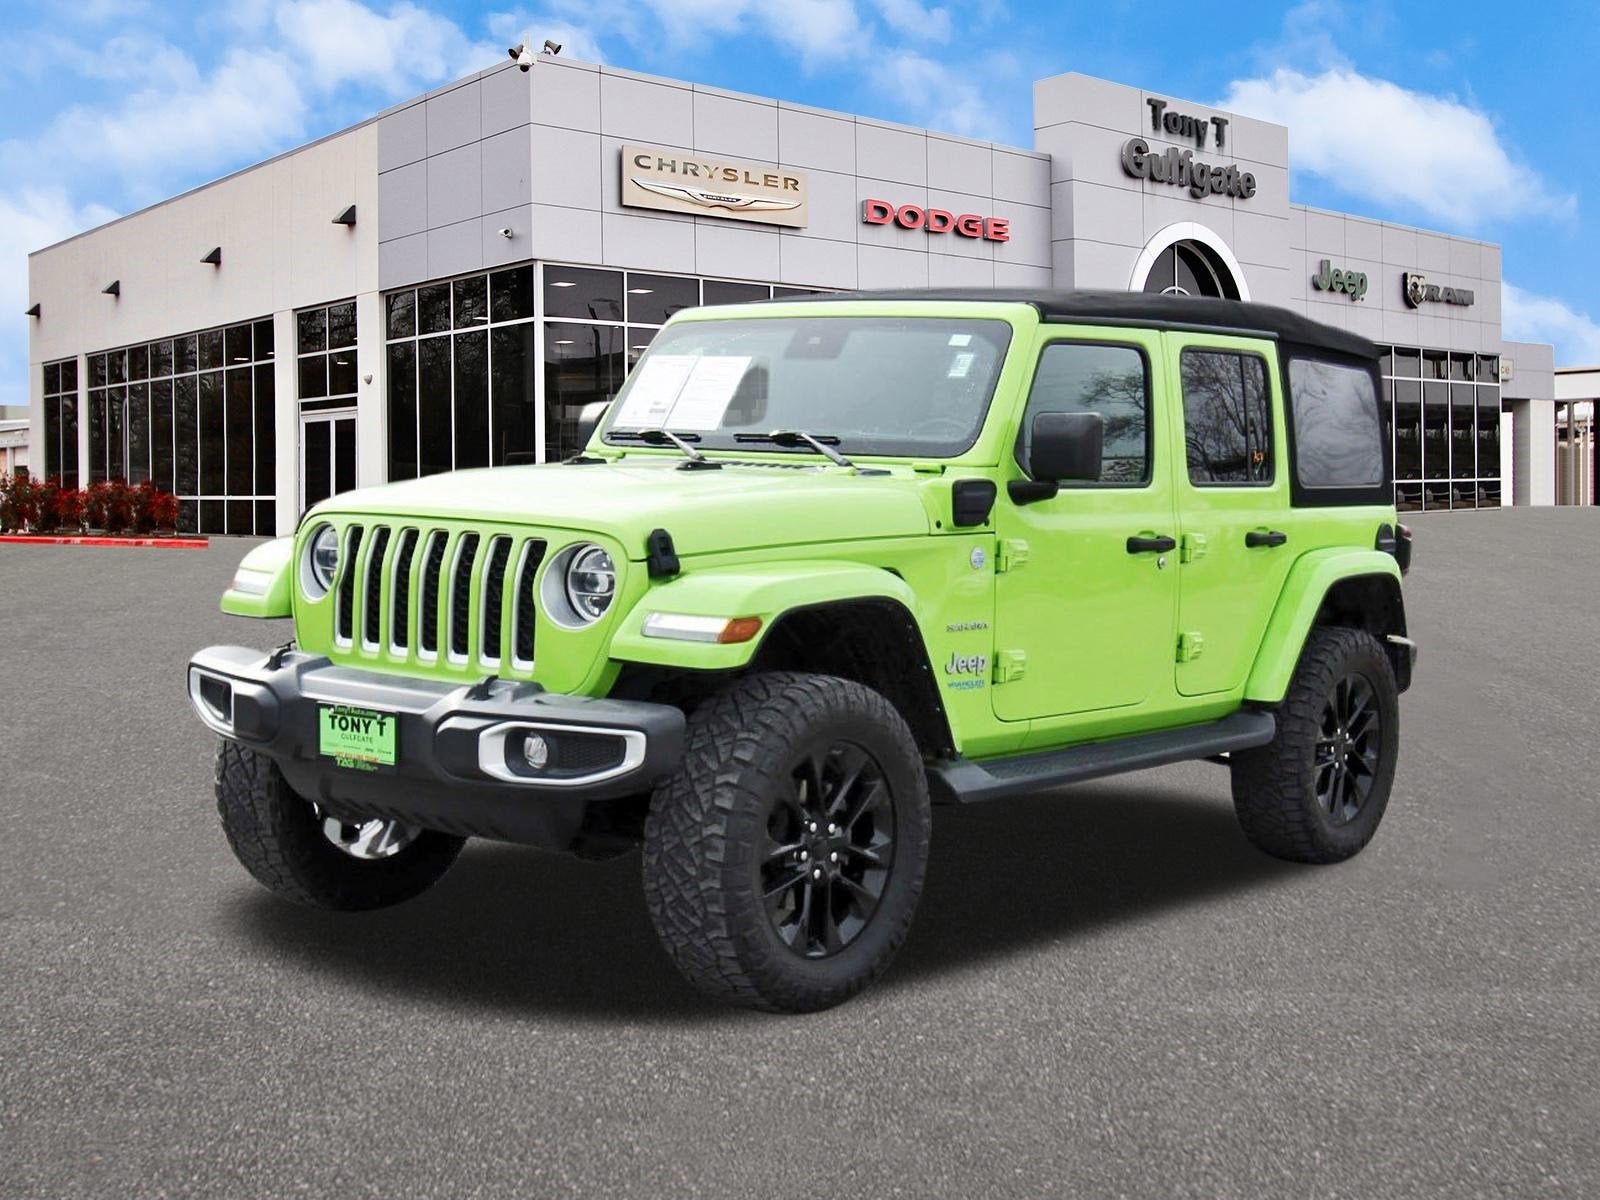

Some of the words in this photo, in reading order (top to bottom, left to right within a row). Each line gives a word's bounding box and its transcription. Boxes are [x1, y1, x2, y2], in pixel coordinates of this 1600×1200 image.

[1146, 98, 1209, 148] Tony
[1210, 116, 1229, 148] T
[633, 154, 801, 193] CHRYSLER
[1121, 137, 1257, 199] Gulfgate
[863, 198, 1010, 242] DODGE
[1312, 259, 1368, 303] Jeep
[1425, 284, 1475, 306] RAM
[945, 652, 986, 676] Jeep
[329, 714, 372, 734] TONY
[376, 720, 387, 737] T
